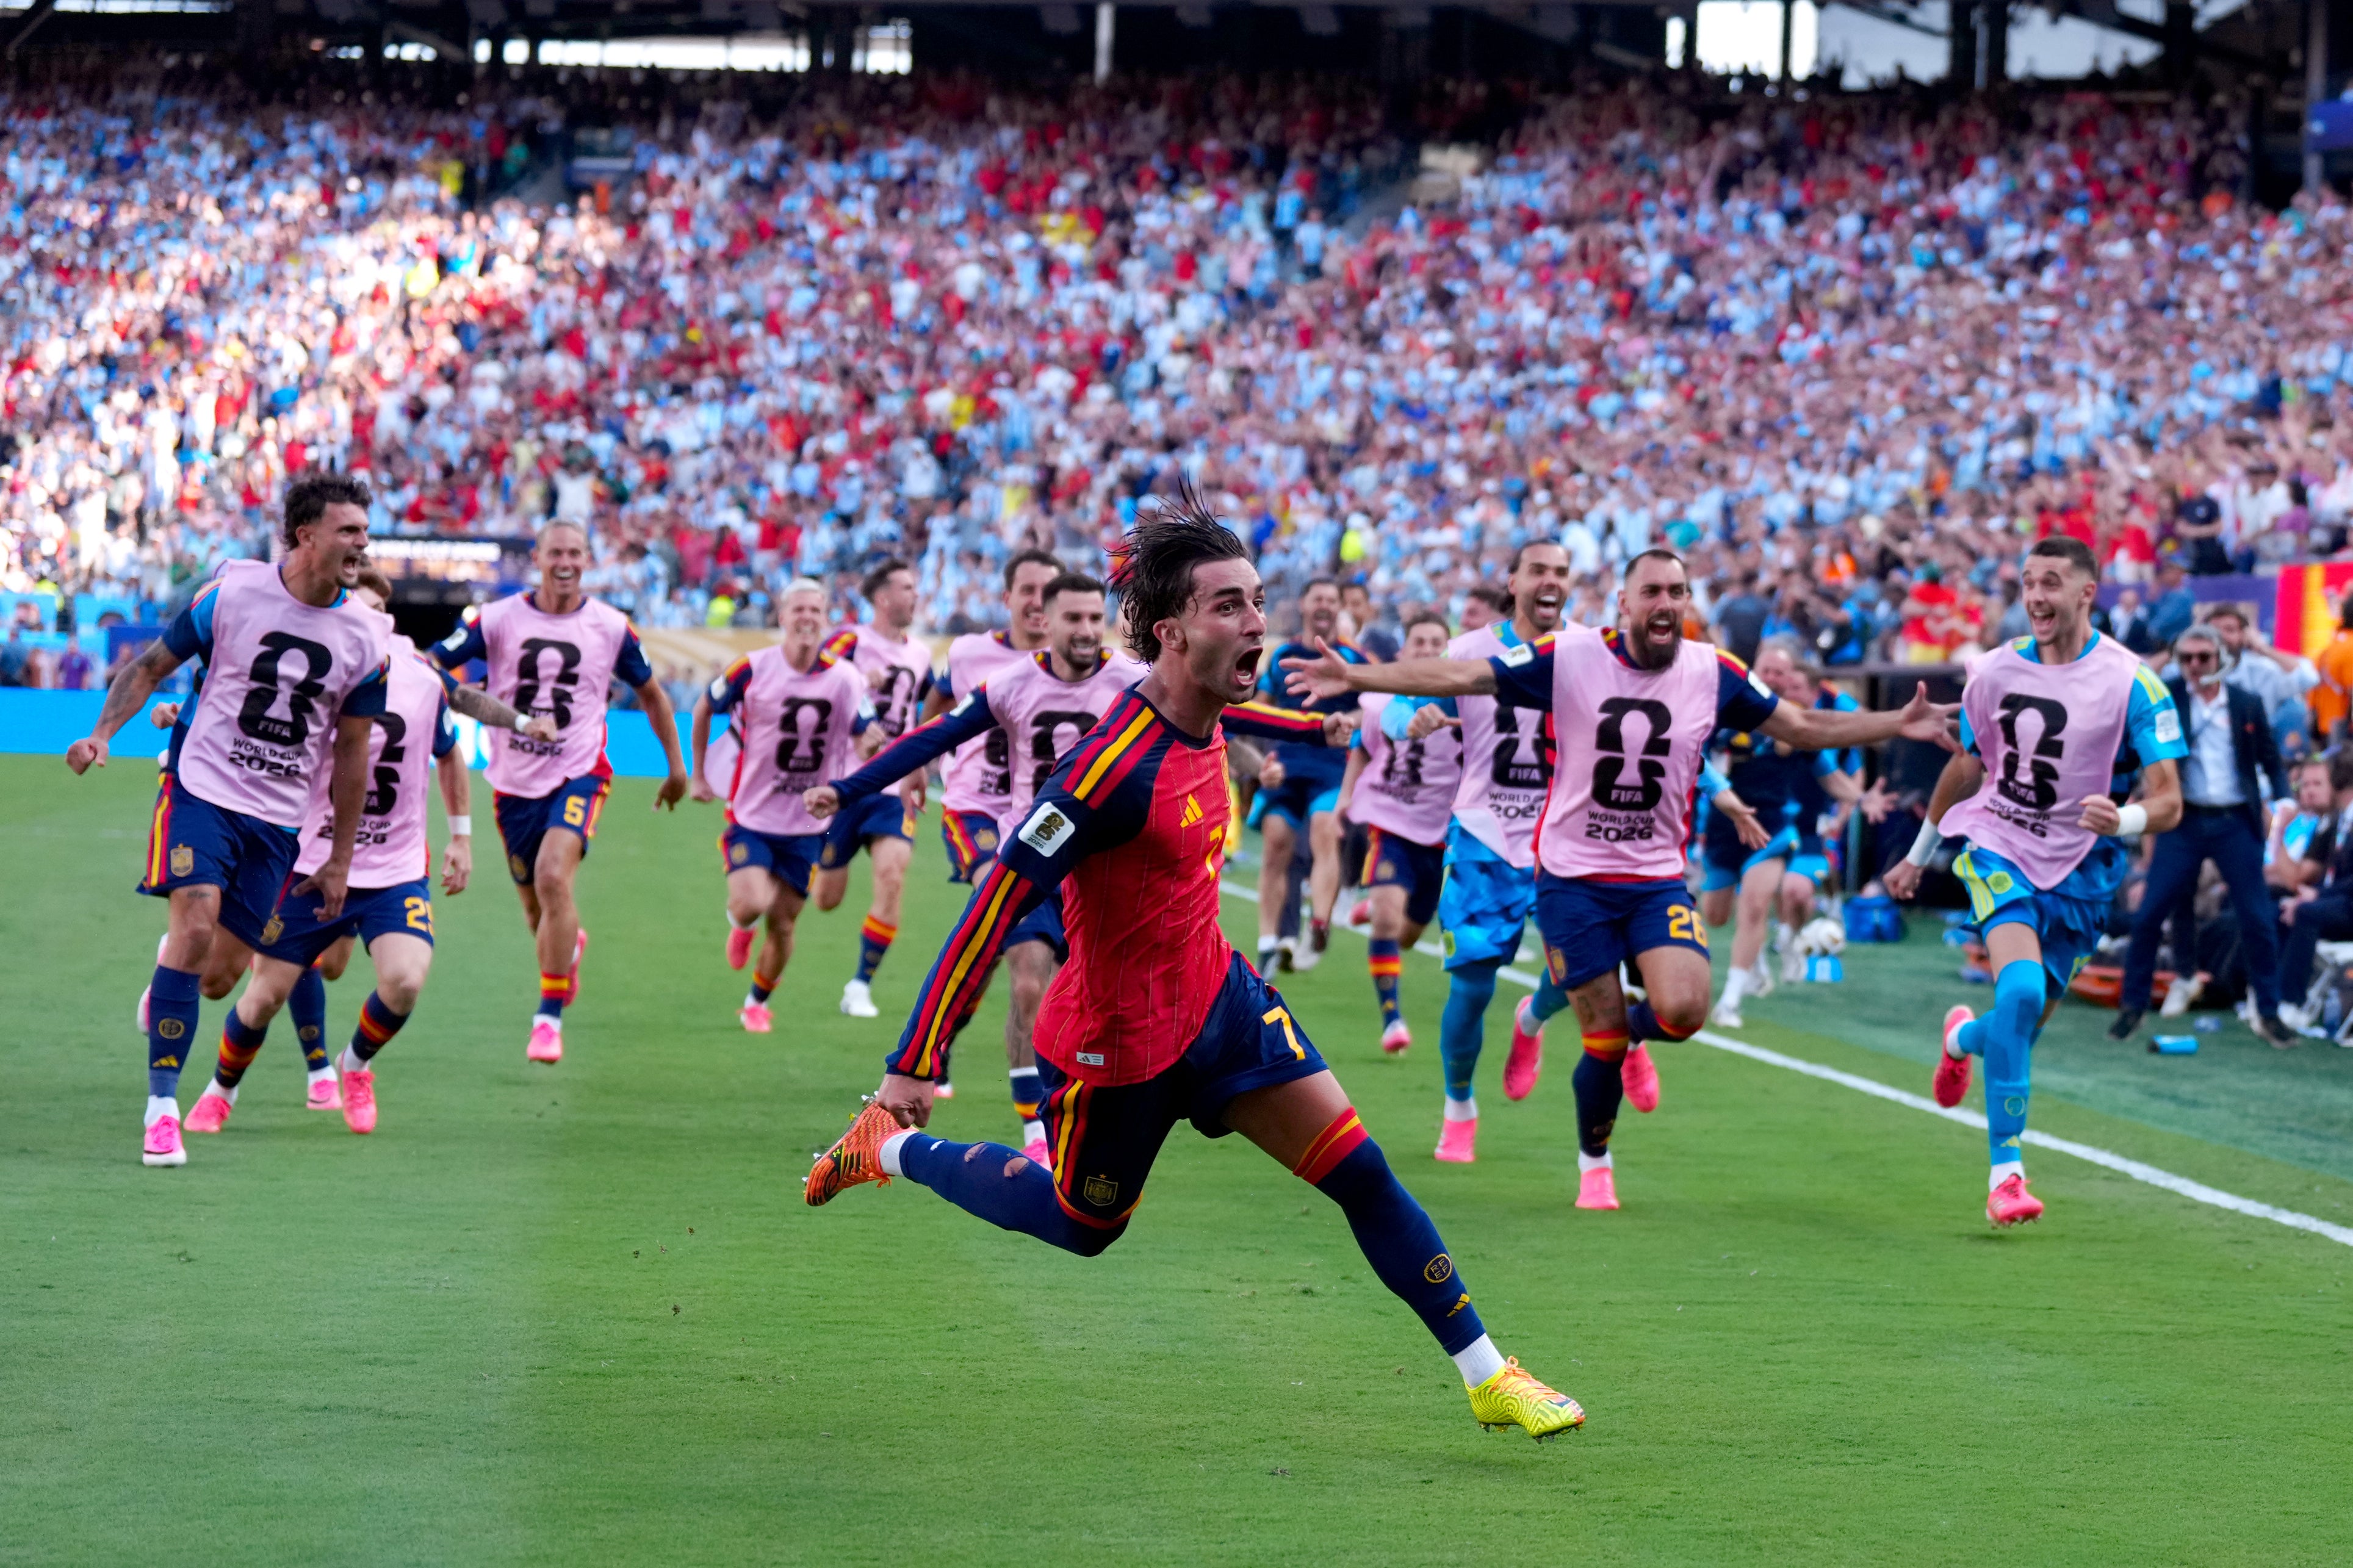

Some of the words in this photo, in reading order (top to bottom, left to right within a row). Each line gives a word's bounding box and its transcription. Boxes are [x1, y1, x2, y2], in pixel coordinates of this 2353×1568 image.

[258, 720, 292, 738] FIFA
[233, 738, 276, 757] WORLD
[229, 752, 301, 777] 2026
[1508, 768, 1542, 781] FIFA
[1488, 791, 1530, 803] WORLD
[1611, 789, 1644, 803] FIFA
[563, 794, 586, 827] 5
[1588, 811, 1631, 824] WORLD
[1632, 816, 1655, 825] CUP
[317, 825, 387, 844] 226
[1585, 823, 1653, 842] 2026
[1027, 837, 1044, 849] 2026
[1205, 825, 1222, 881] 7
[1667, 905, 1708, 949] 26
[1262, 1005, 1305, 1060] 7
